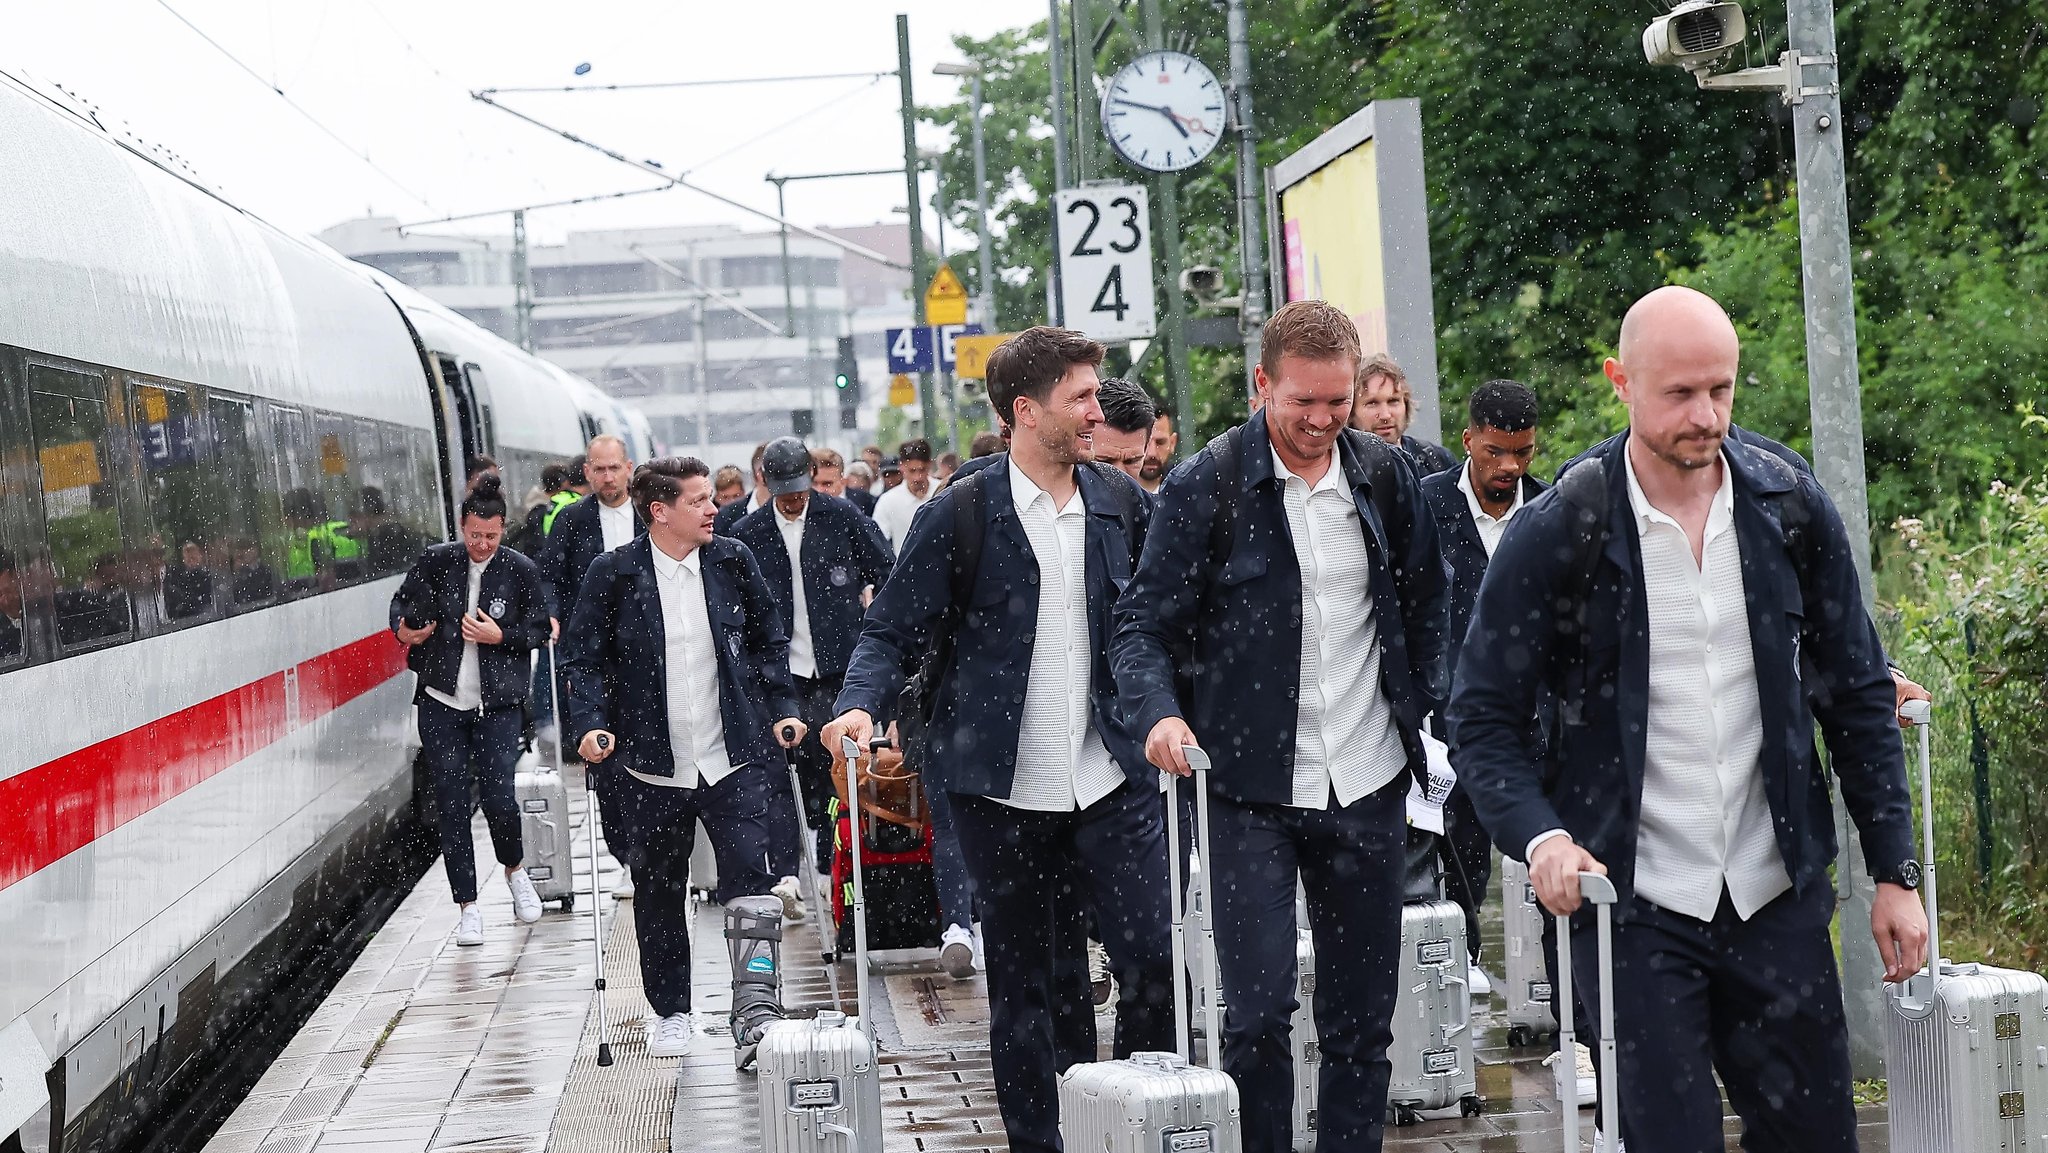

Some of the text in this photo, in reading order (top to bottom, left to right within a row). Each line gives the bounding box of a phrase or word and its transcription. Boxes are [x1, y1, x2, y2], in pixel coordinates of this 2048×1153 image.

[1067, 197, 1142, 257] 23
[1090, 264, 1130, 321] 4
[890, 327, 918, 365] 4
